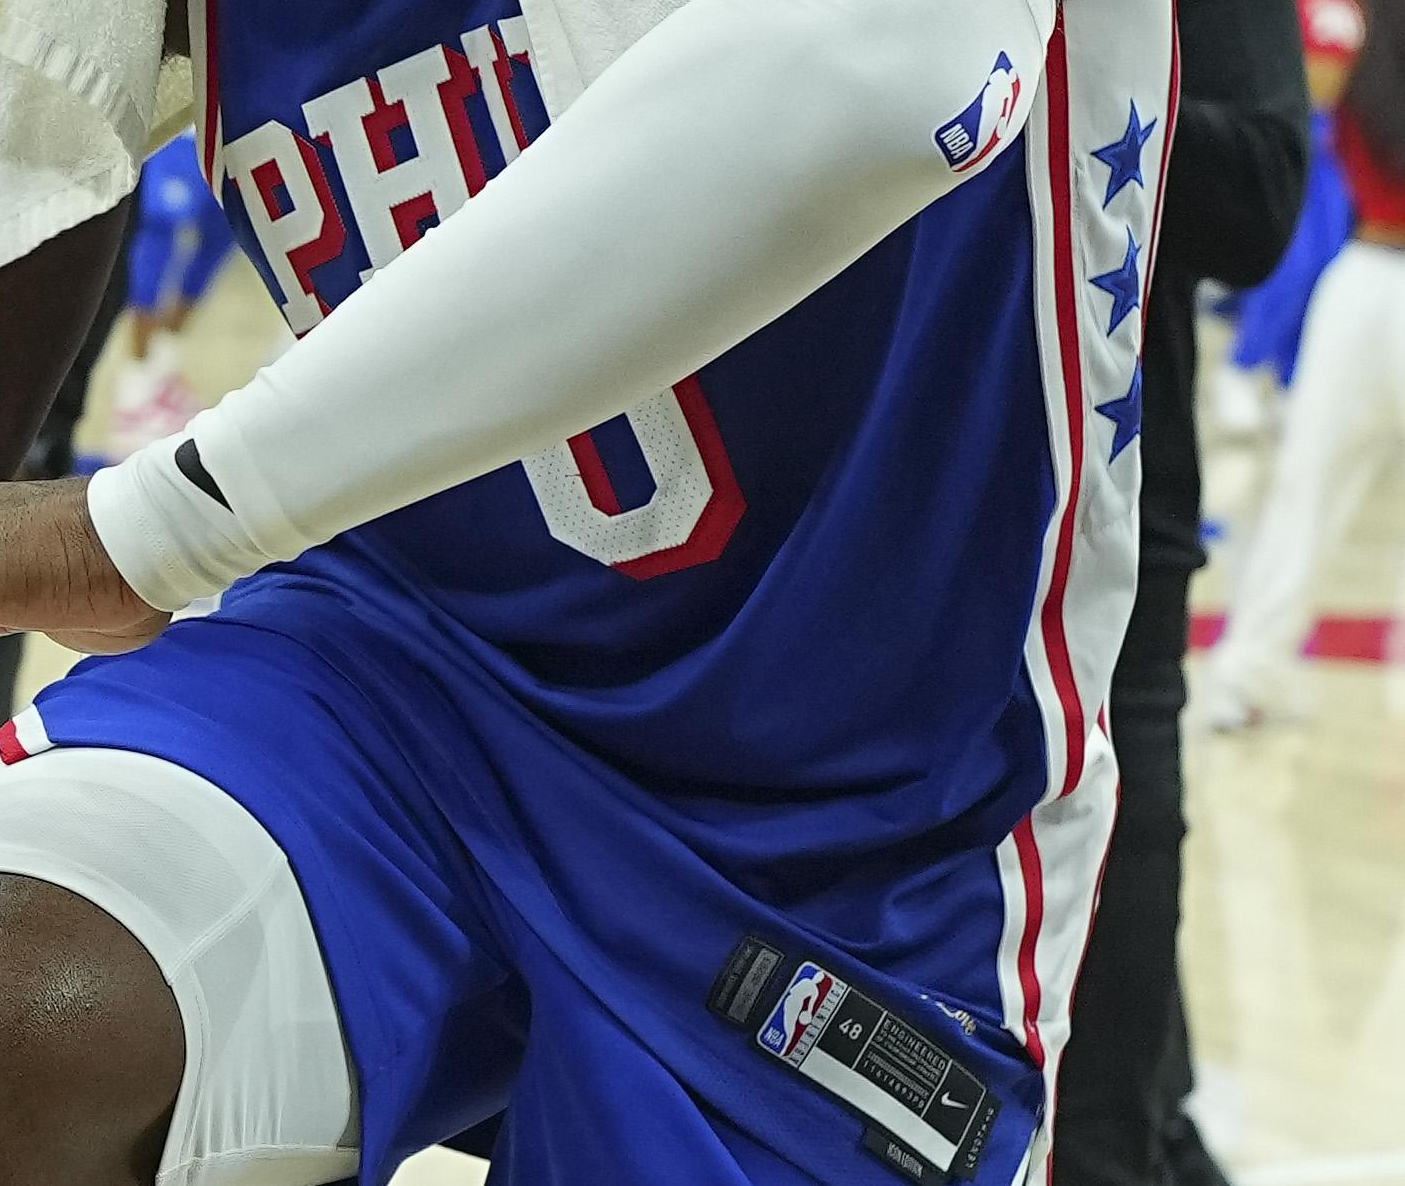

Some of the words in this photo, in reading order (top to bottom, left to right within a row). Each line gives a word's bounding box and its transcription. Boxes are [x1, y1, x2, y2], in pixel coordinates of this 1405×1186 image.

[940, 123, 975, 160] NBA
[223, 15, 535, 339] PHI
[763, 1026, 785, 1048] NBA
[838, 1018, 863, 1040] 48
